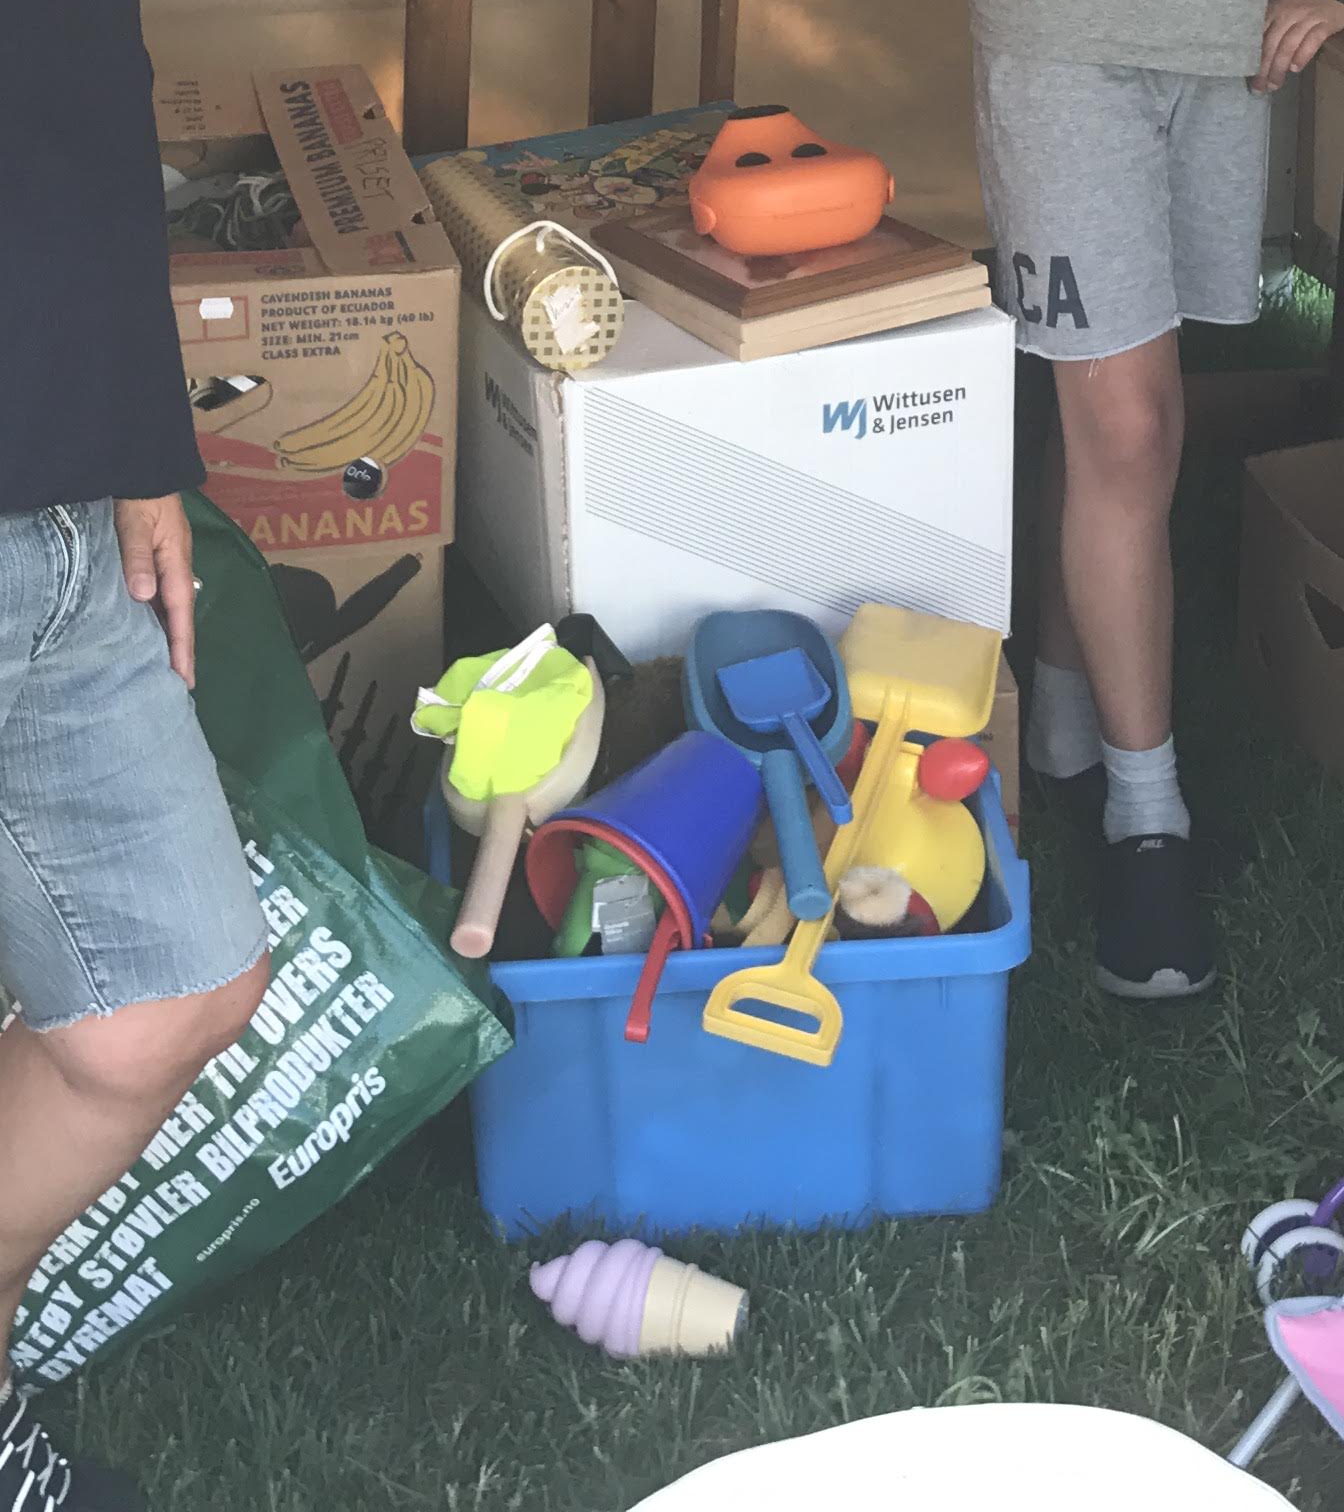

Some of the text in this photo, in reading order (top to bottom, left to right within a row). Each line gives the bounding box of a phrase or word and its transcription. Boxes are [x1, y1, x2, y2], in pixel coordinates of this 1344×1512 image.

[279, 80, 337, 163] BANANAS
[310, 160, 369, 235] PREMIUM
[260, 287, 393, 305] CAVENDISH BANANAS
[261, 301, 395, 318] PRODUCT OF ECUADOR
[1012, 251, 1090, 330] CA
[261, 321, 285, 332] NET
[289, 318, 342, 331] WEIGHT:
[379, 313, 394, 326] kg
[296, 333, 326, 345] MIN.
[261, 345, 341, 361] CLASS EXTRA
[872, 386, 967, 413] Wittusen
[872, 409, 954, 435] & Jensen
[236, 499, 430, 545] ANANAS
[141, 1091, 216, 1171] MER
[203, 1042, 260, 1100] TIL
[249, 926, 353, 1046] OVERS
[78, 1170, 212, 1289] STØVLER
[195, 970, 396, 1183] BILPRODUKTER
[267, 1066, 387, 1190] Europris
[196, 1197, 261, 1263] europris.no
[36, 1256, 174, 1382] DYREMAT
